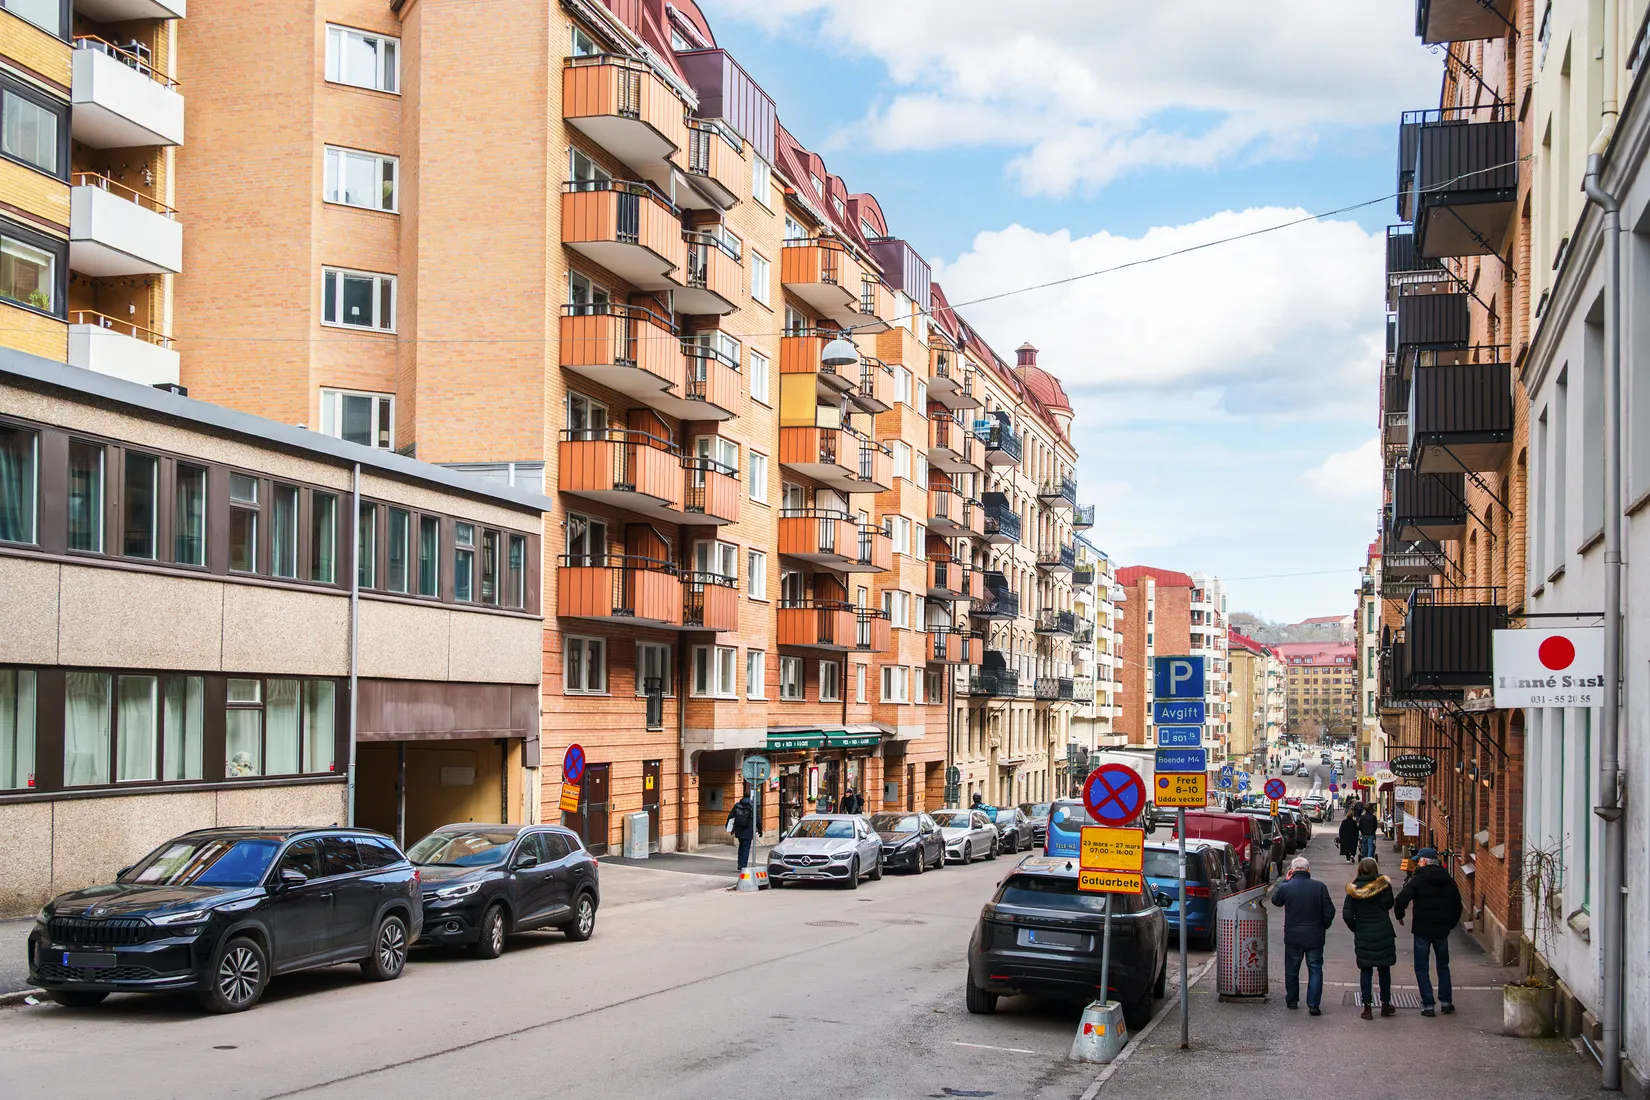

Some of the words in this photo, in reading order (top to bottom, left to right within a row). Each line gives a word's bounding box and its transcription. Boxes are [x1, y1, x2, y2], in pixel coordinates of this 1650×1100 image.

[1169, 660, 1193, 695] P
[1530, 695, 1546, 704] 031
[1554, 695, 1566, 703] 55
[1567, 694, 1578, 703] 20
[1580, 694, 1591, 703] 55
[1161, 706, 1198, 720] Avgift
[1158, 756, 1185, 764] Boende
[1187, 755, 1200, 763] M4
[1392, 755, 1435, 764] RESTAURANT
[1394, 769, 1432, 777] BRASSERIE
[1176, 776, 1197, 785] Fred
[1175, 785, 1198, 794] 8-10
[1157, 795, 1176, 803] Udda
[1178, 795, 1204, 803] veckor
[1081, 875, 1140, 888] Gatuarbete
